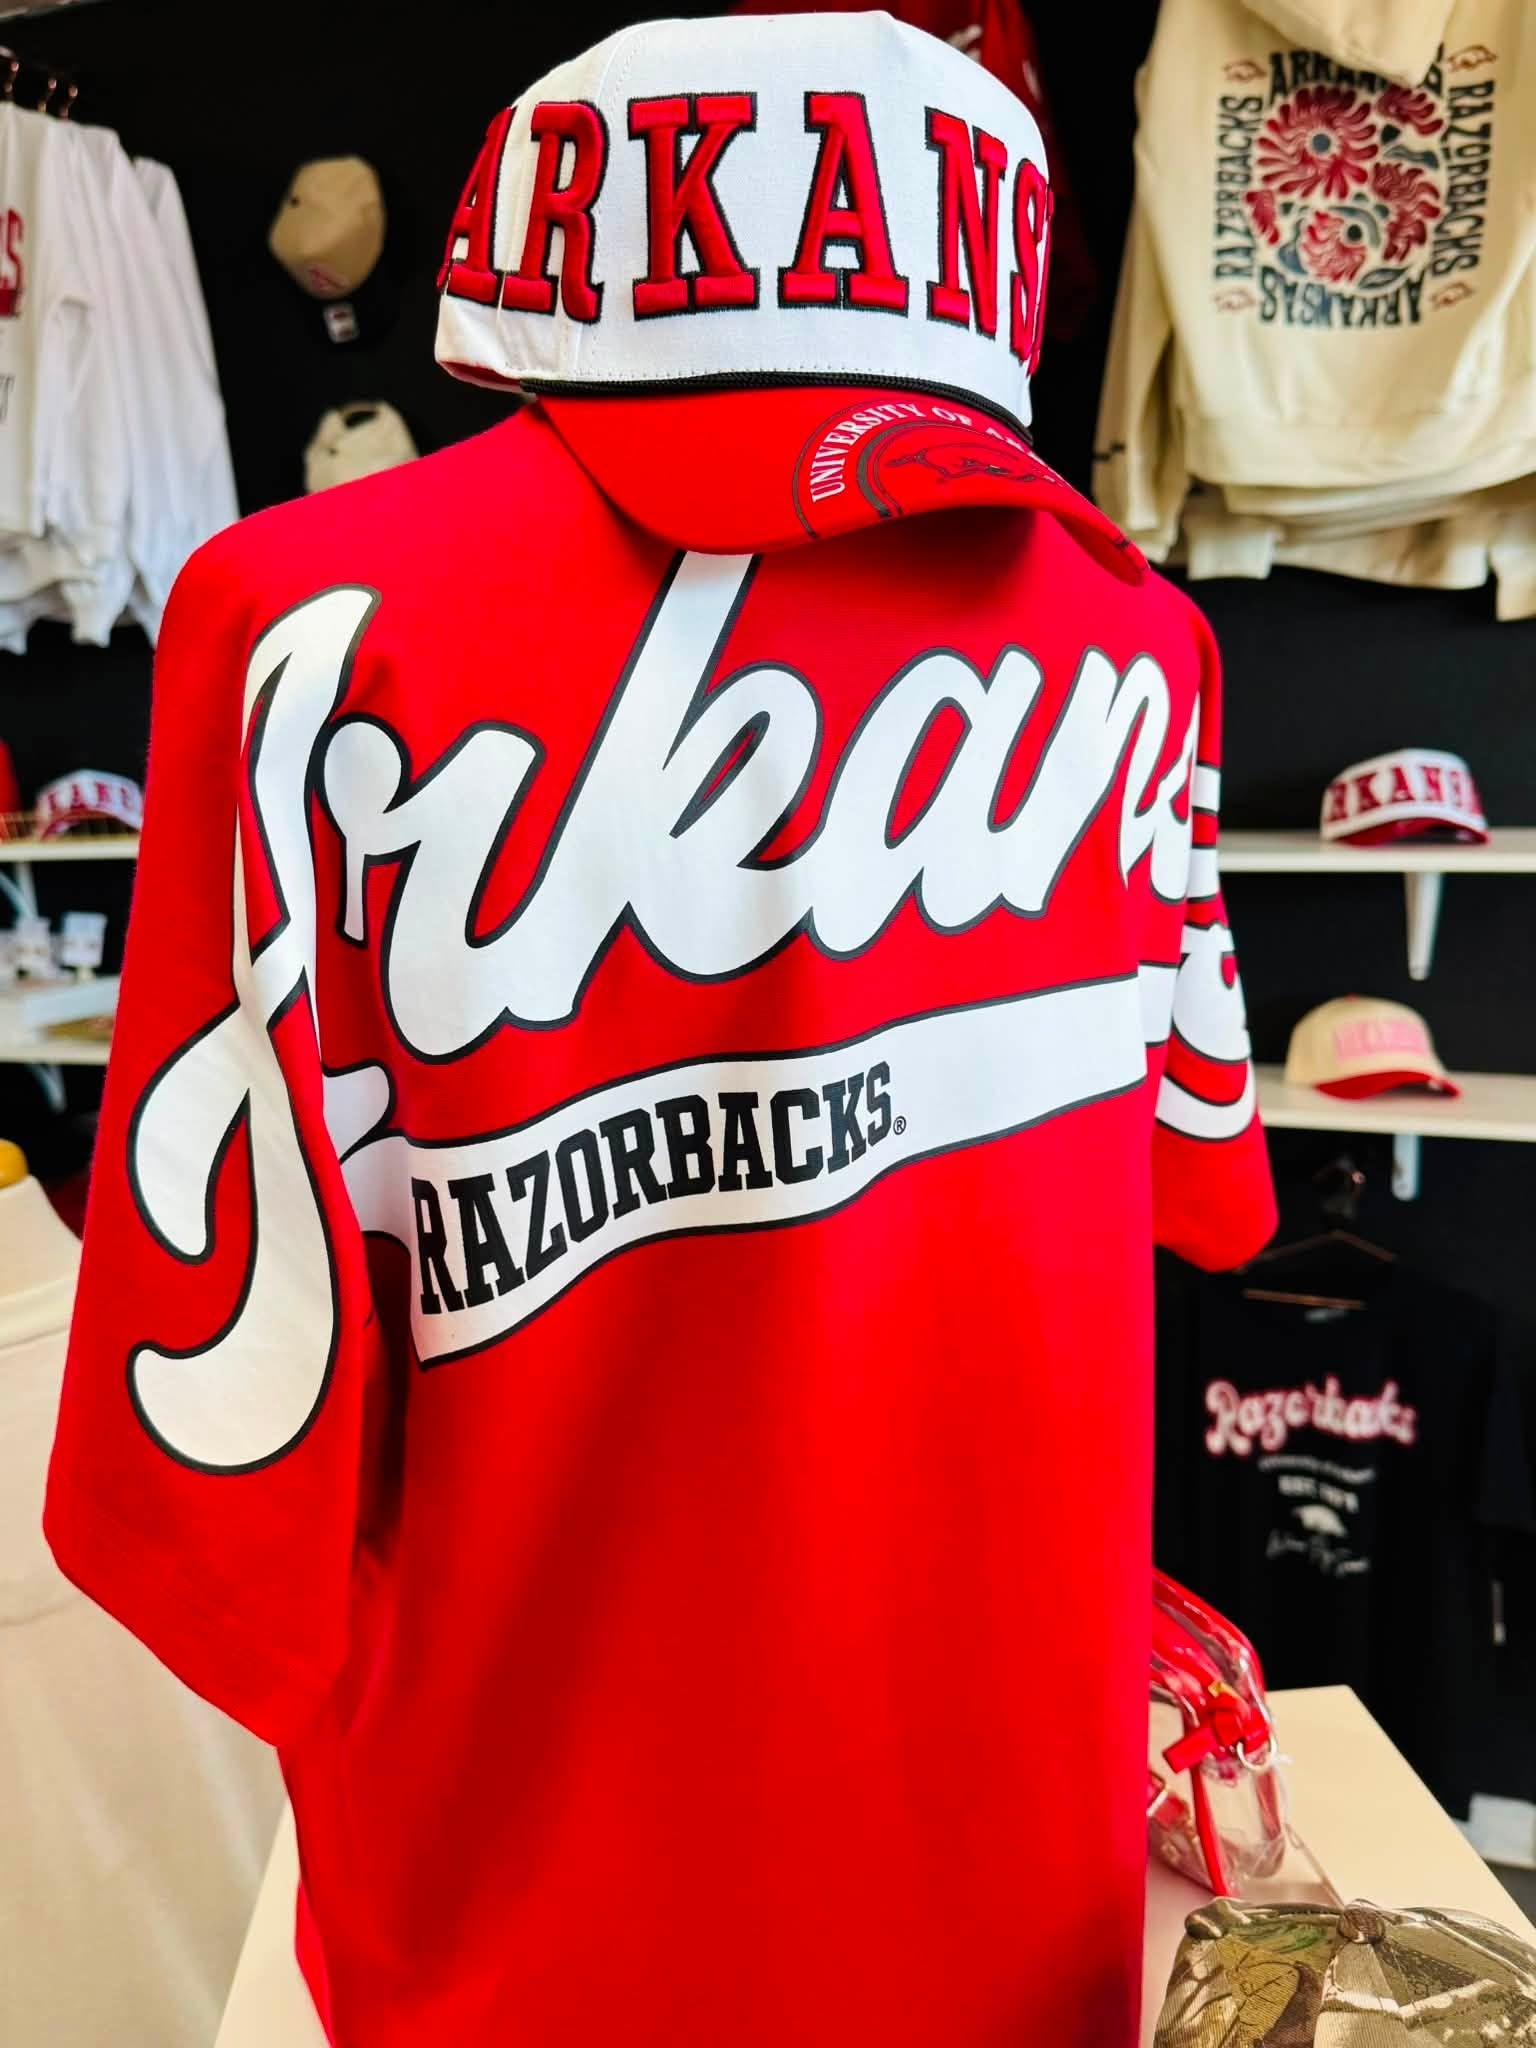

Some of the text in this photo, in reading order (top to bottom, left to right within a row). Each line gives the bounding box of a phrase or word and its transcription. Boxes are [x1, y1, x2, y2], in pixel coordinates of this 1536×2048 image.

[436, 92, 1054, 377] ARKANS
[1214, 95, 1262, 280] RAZORBACKS
[810, 403, 925, 502] UNIVERSITY
